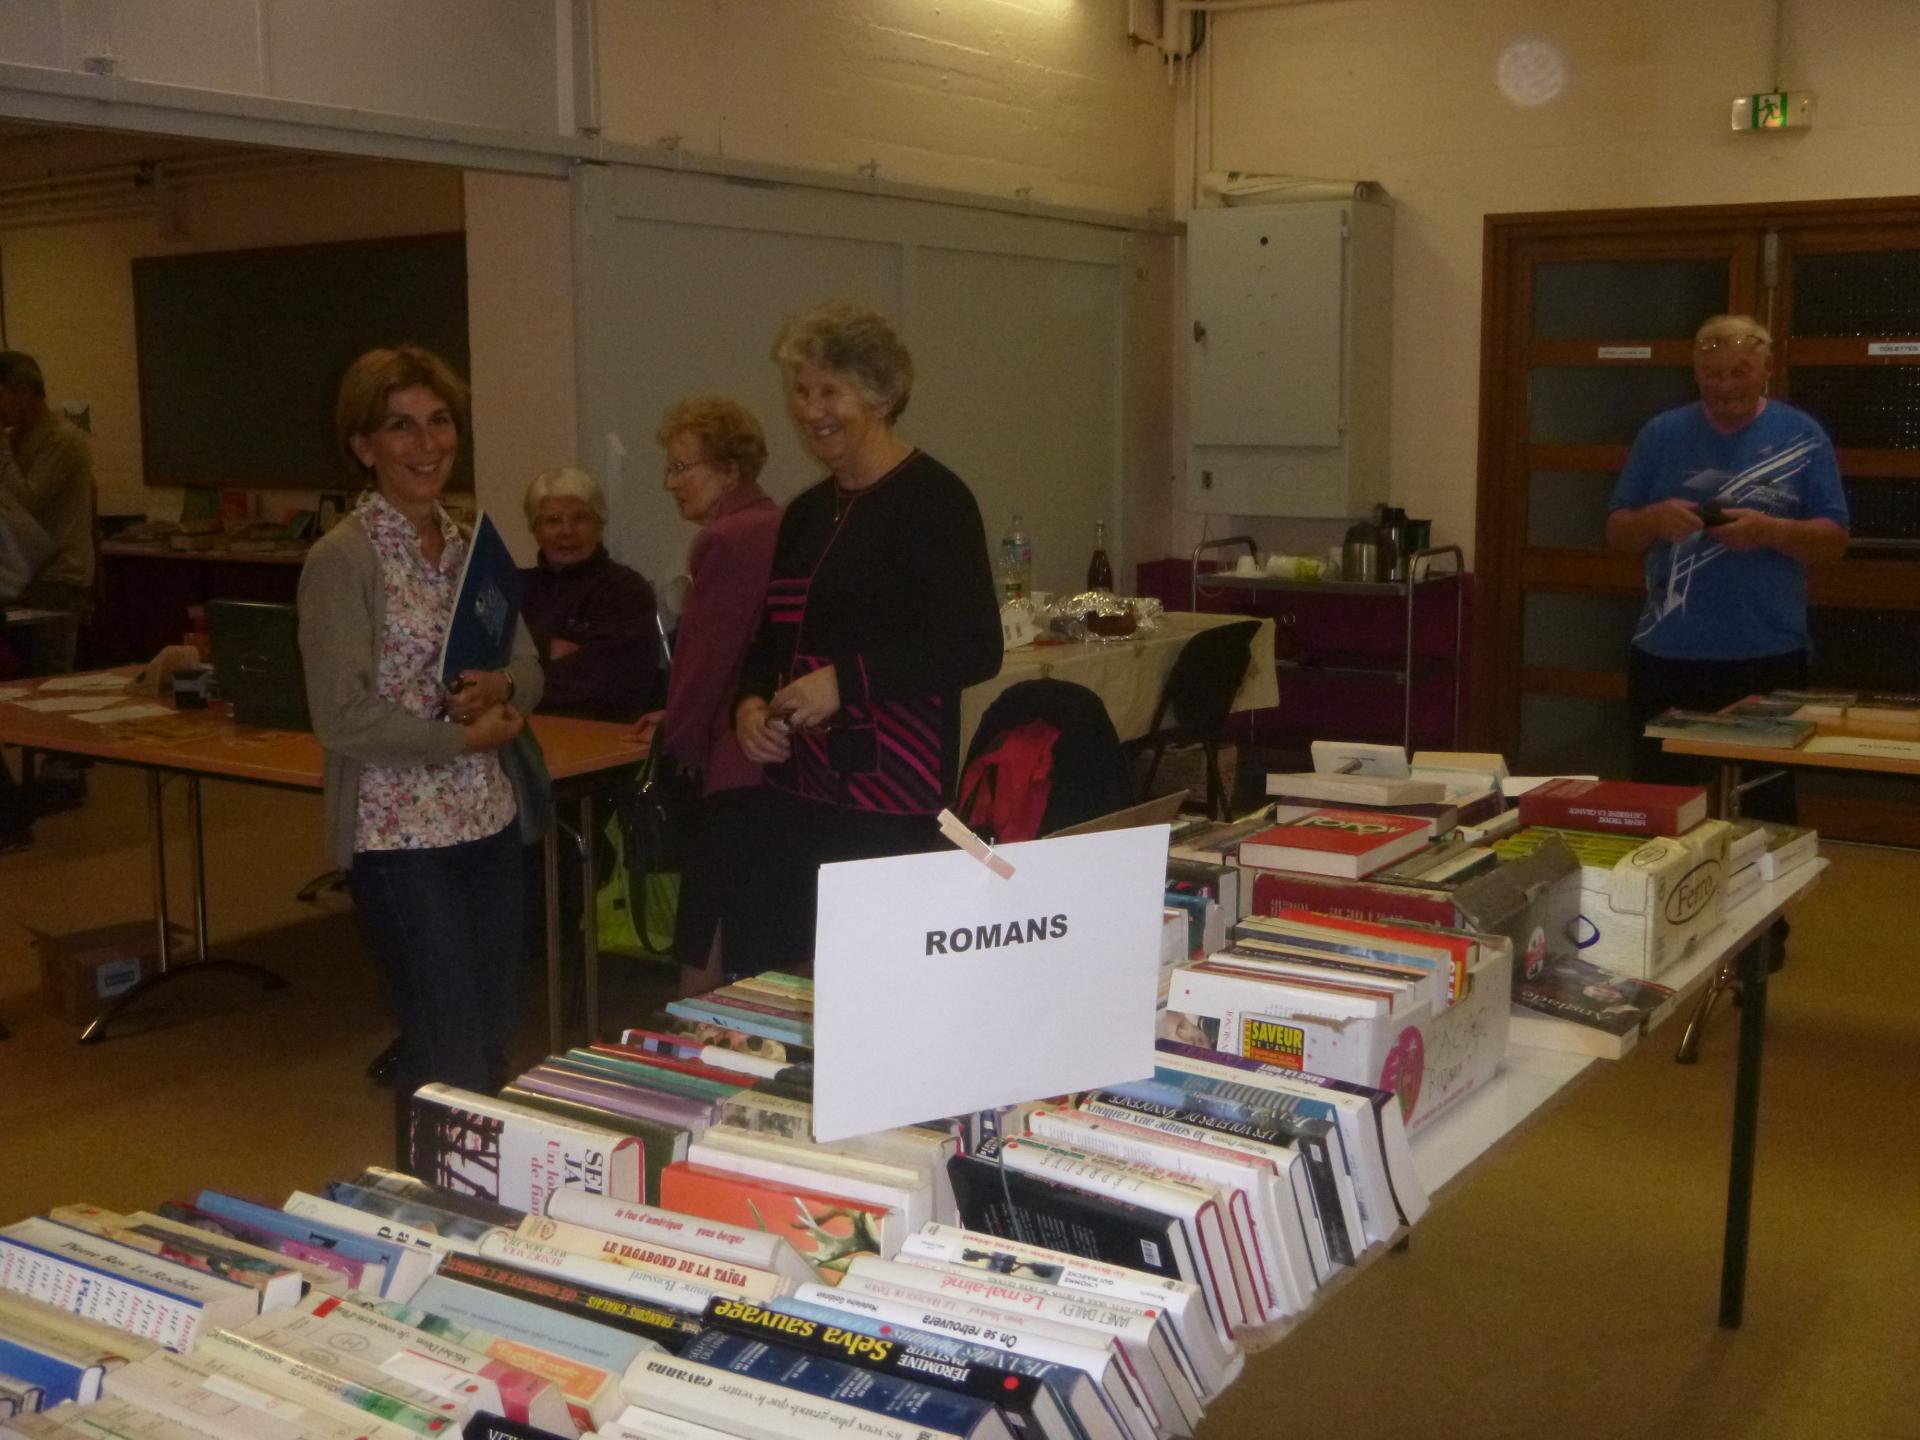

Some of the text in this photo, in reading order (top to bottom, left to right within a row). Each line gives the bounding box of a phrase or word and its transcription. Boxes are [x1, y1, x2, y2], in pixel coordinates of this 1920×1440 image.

[925, 913, 1069, 956] ROMANS
[1251, 1018, 1304, 1048] SAVEUR
[1086, 1103, 1130, 1123] cailloux
[1131, 1114, 1154, 1127] aux
[1155, 1119, 1192, 1136] soupe
[1192, 1130, 1205, 1142] la
[547, 1141, 560, 1164] Un
[531, 1157, 543, 1177] de
[716, 1231, 745, 1246] berger
[603, 1241, 748, 1287] LE VAGABOND DE LA TAÏGA
[628, 1270, 676, 1292] Boissard
[940, 1272, 1020, 1306] mal-aimé
[585, 1294, 627, 1316] CHALAIS
[1019, 1291, 1044, 1310] Le
[627, 1305, 676, 1329] FRANÇOIS
[712, 1296, 815, 1341] sauvage
[1059, 1301, 1099, 1323] DAILEY
[1098, 1310, 1131, 1330] JANET
[921, 1313, 981, 1339] retrouvera
[983, 1329, 998, 1341] se
[820, 1324, 893, 1363] Selva
[999, 1333, 1017, 1349] On
[645, 1359, 714, 1391] cavanna
[897, 1351, 970, 1384] JÉROMINE
[717, 1382, 754, 1401] ventre
[753, 1393, 765, 1407] le
[765, 1393, 789, 1411] que
[787, 1400, 829, 1423] grands
[828, 1412, 855, 1431] plus
[856, 1420, 883, 1436] yeux
